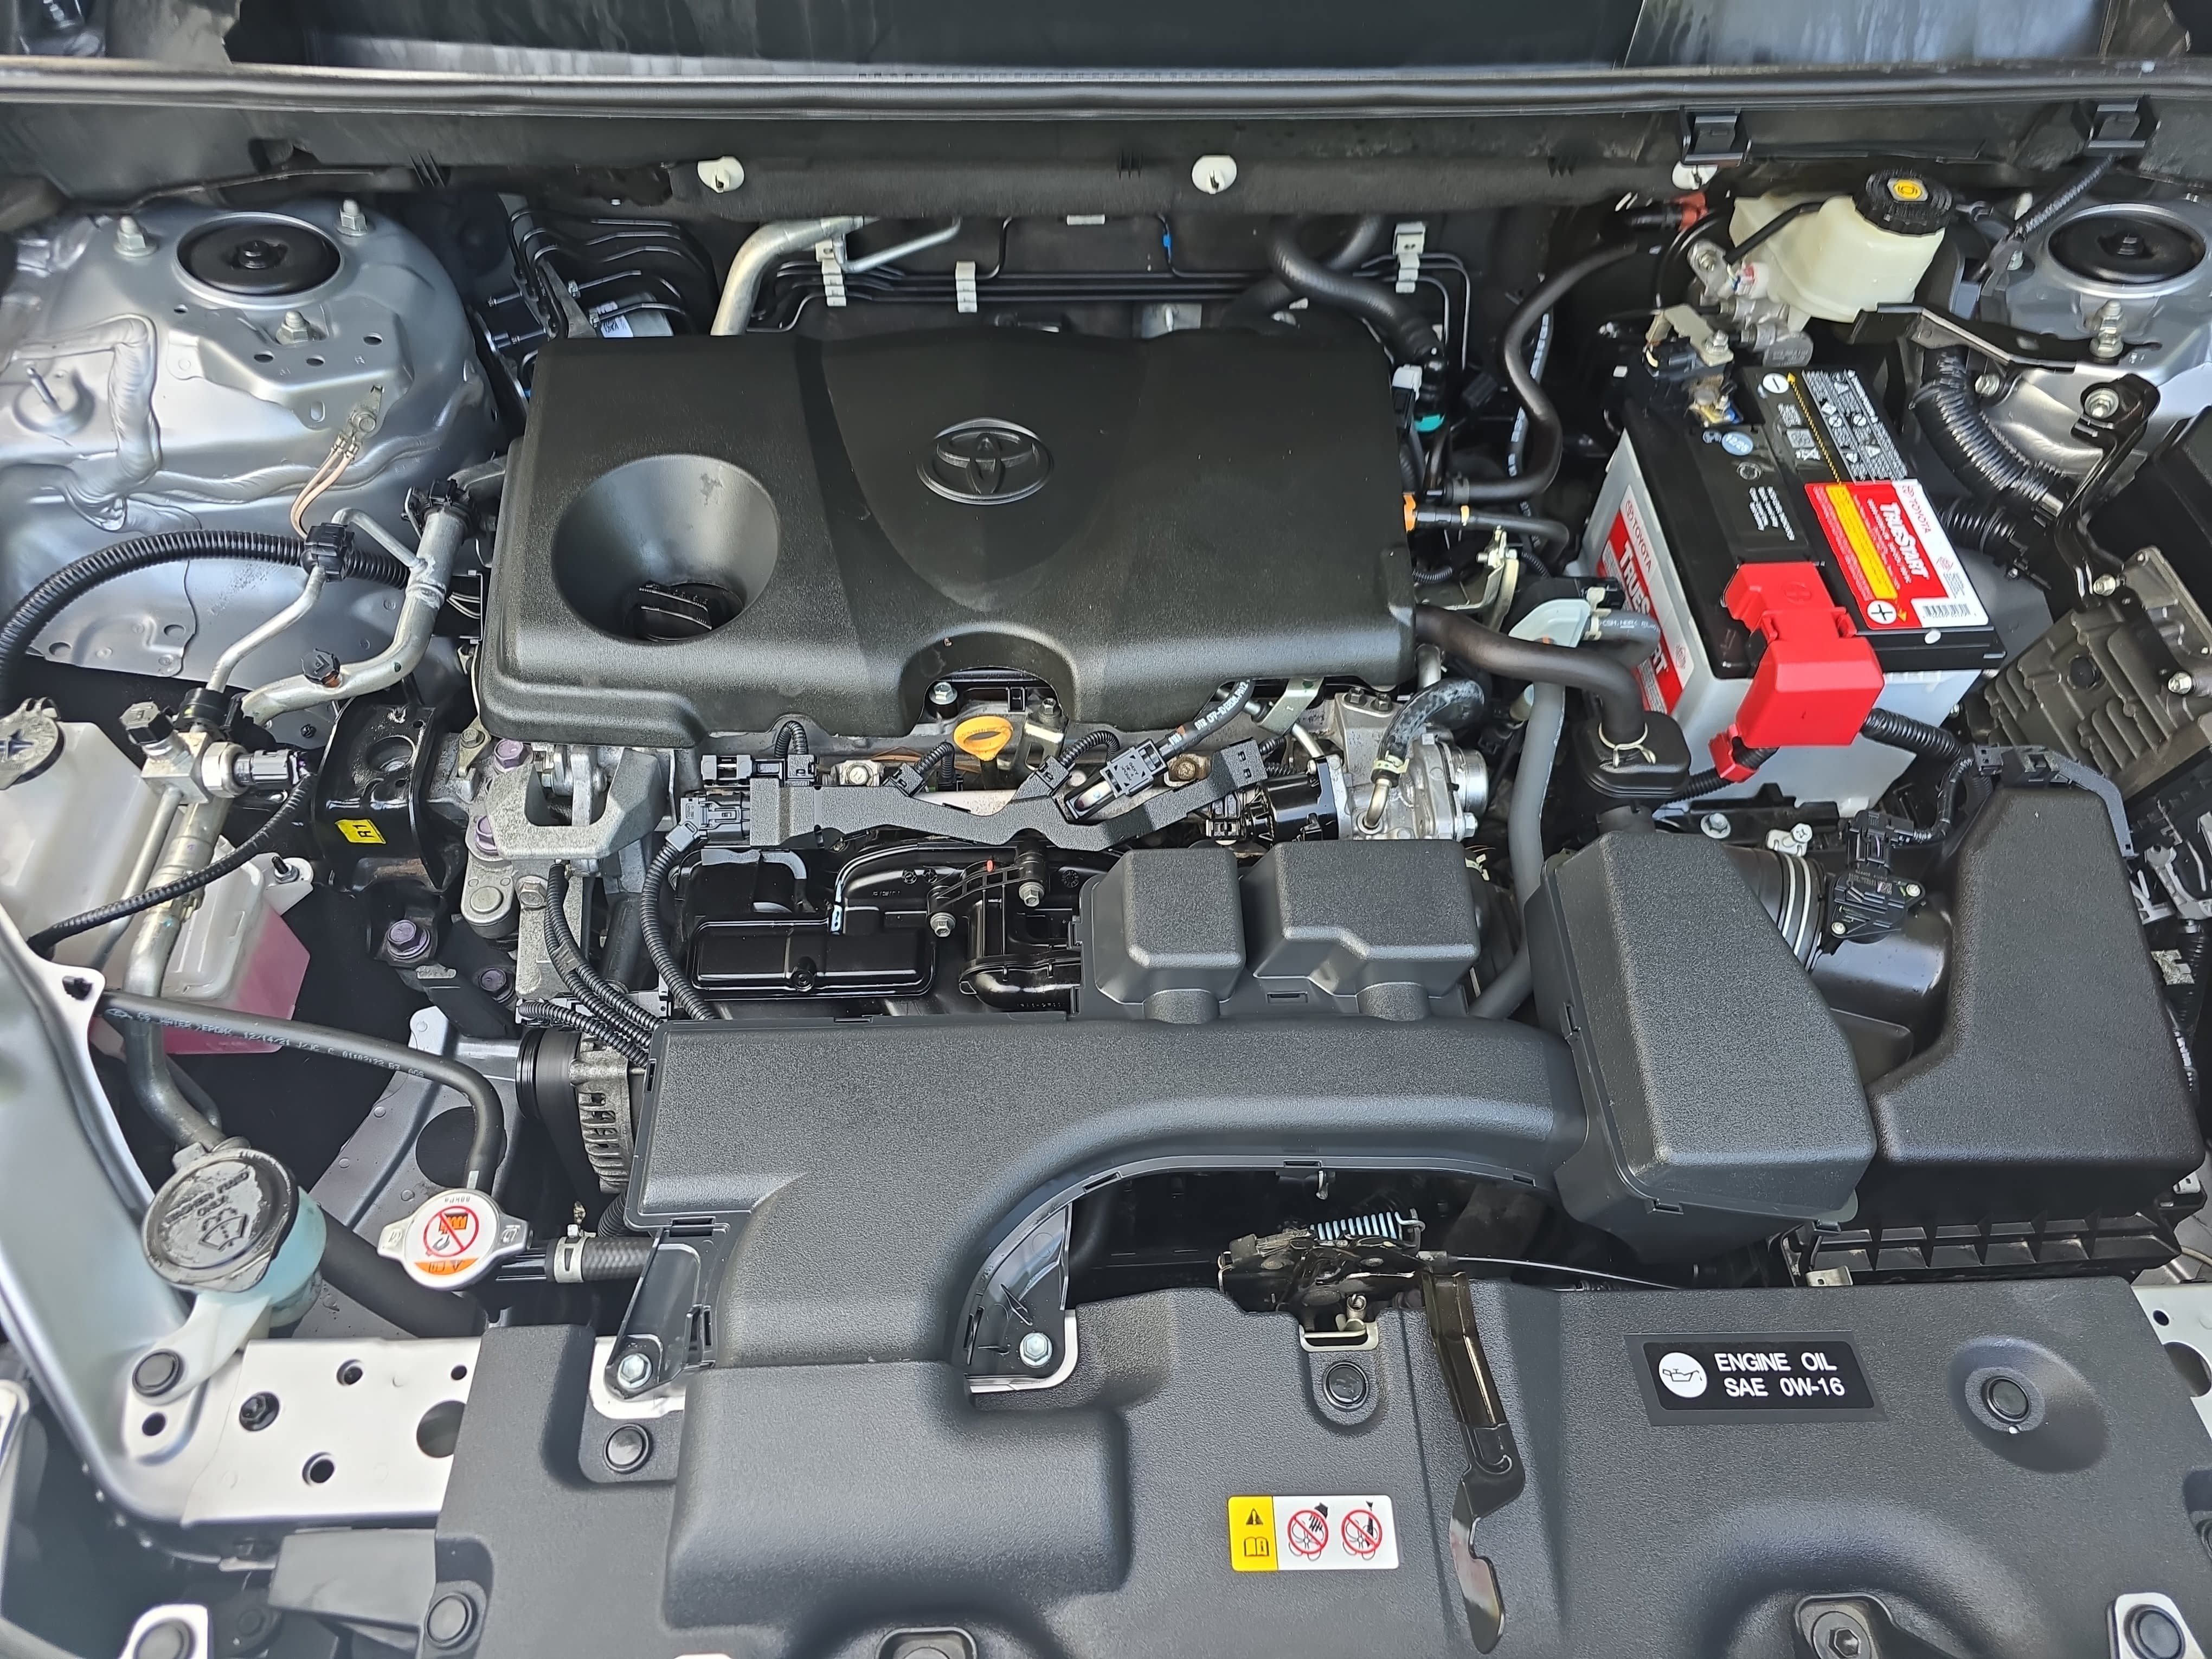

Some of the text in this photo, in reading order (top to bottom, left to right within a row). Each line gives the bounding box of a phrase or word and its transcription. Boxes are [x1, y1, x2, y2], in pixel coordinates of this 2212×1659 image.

[1726, 434, 1750, 452] 12/25
[1910, 499, 1931, 533] TOYOTA
[1632, 518, 1652, 573] TOYOTA
[1619, 540, 1669, 676] TRUESRT
[352, 825, 375, 838] R1
[243, 1031, 291, 1046] 12/14/21
[164, 1171, 249, 1224] WASHER FLUID
[197, 1194, 229, 1217] ONLY
[1714, 1352, 1837, 1372] ENGINE OIL
[1724, 1377, 1846, 1397] SAE 0W-16
